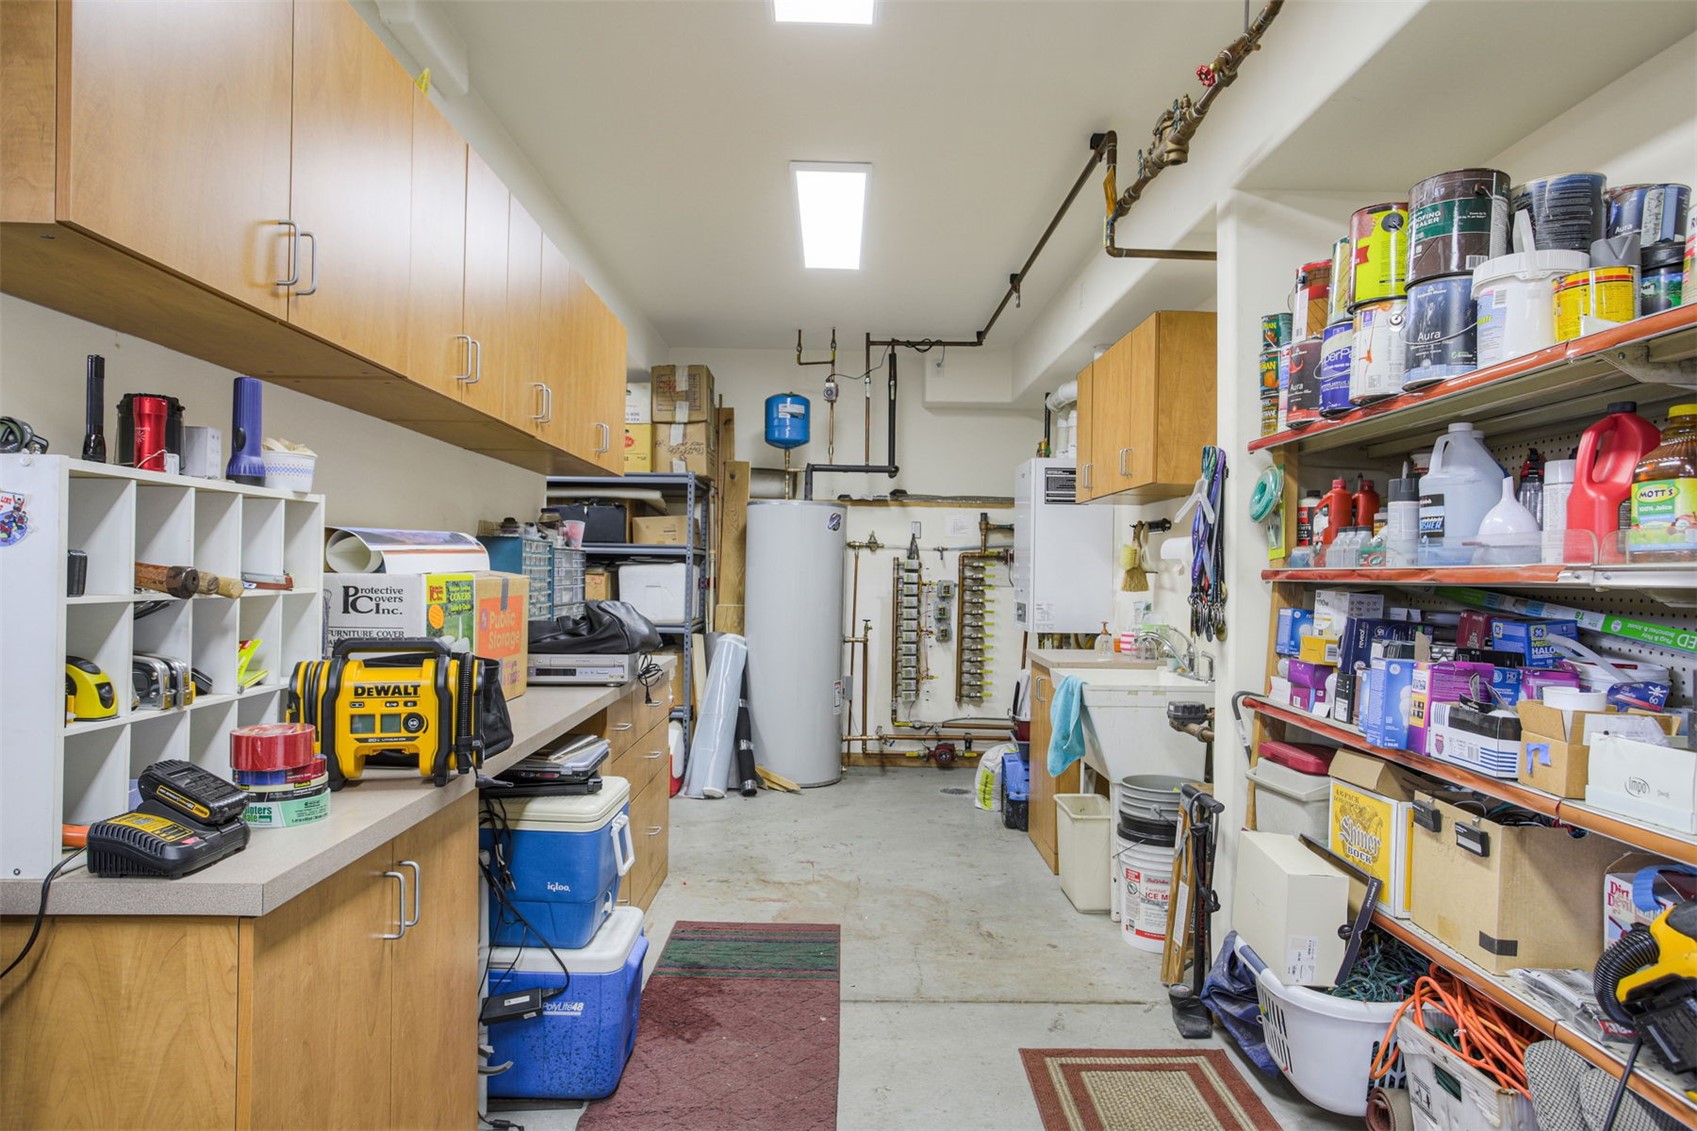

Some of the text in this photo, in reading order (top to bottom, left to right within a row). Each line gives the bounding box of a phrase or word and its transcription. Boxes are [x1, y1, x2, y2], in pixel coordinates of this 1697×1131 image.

[1614, 225, 1633, 234] Aura
[1417, 331, 1441, 341] Aura
[1289, 383, 1304, 391] Aura
[350, 595, 404, 615] Covers
[374, 602, 404, 615] Inc.
[489, 610, 516, 629] Public
[376, 630, 405, 638] COVER
[488, 630, 520, 651] Storage
[354, 684, 421, 697] DEWALT
[1338, 815, 1381, 856] Shiner
[1346, 845, 1374, 865] BOCK
[547, 881, 571, 893] igloo
[1145, 891, 1159, 900] ICE
